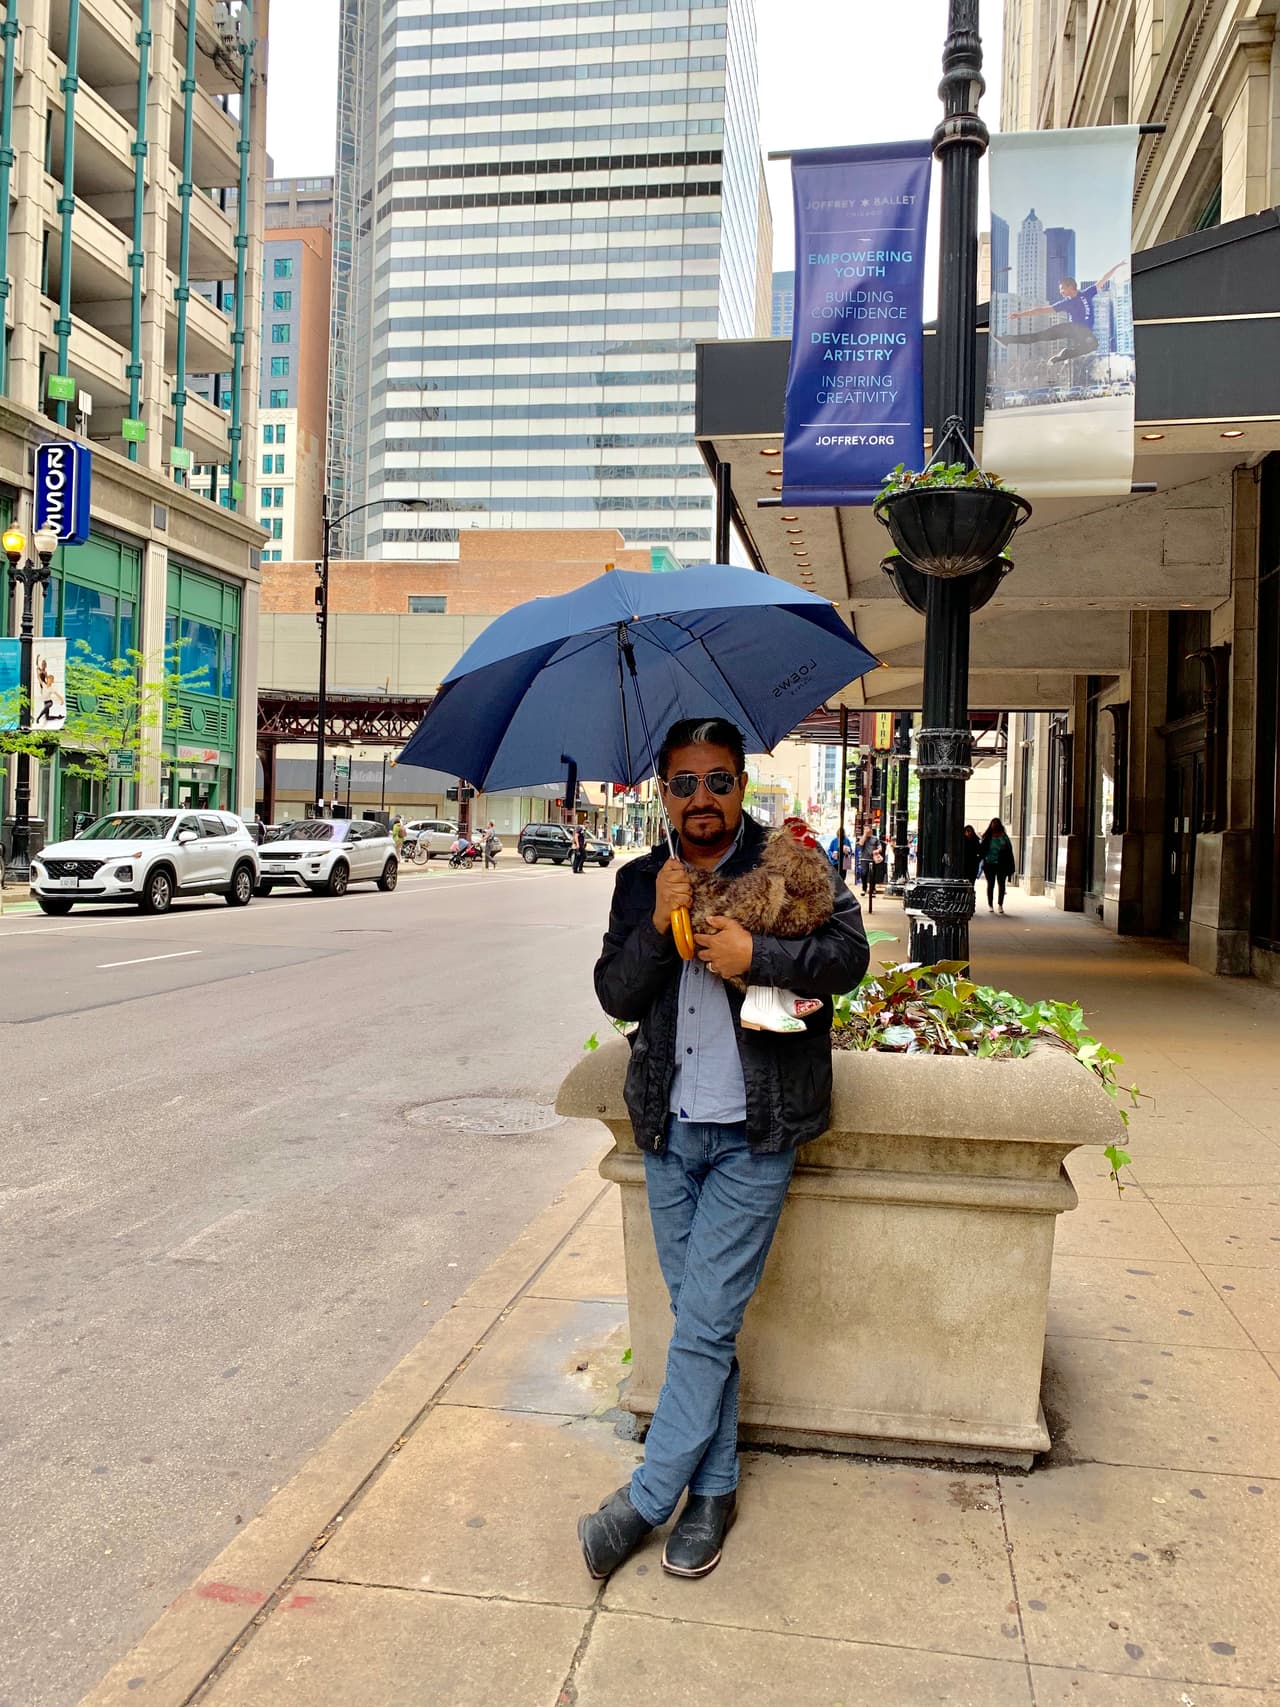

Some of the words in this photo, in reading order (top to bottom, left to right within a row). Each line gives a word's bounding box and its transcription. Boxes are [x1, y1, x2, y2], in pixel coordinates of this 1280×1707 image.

[805, 199, 856, 210] JOFFREY
[873, 195, 917, 207] BALLET
[808, 250, 913, 265] EMPOWERING
[834, 265, 886, 278] YOUTH
[825, 290, 894, 303] BUILDING
[811, 306, 908, 320] CONFIDENCE
[811, 332, 907, 346] DEVELOPING
[823, 348, 894, 361] ARTISTRY
[821, 375, 893, 388] INSPIRING
[816, 391, 899, 404] CREATIVITY
[815, 435, 895, 446] JOFFREY.ORG
